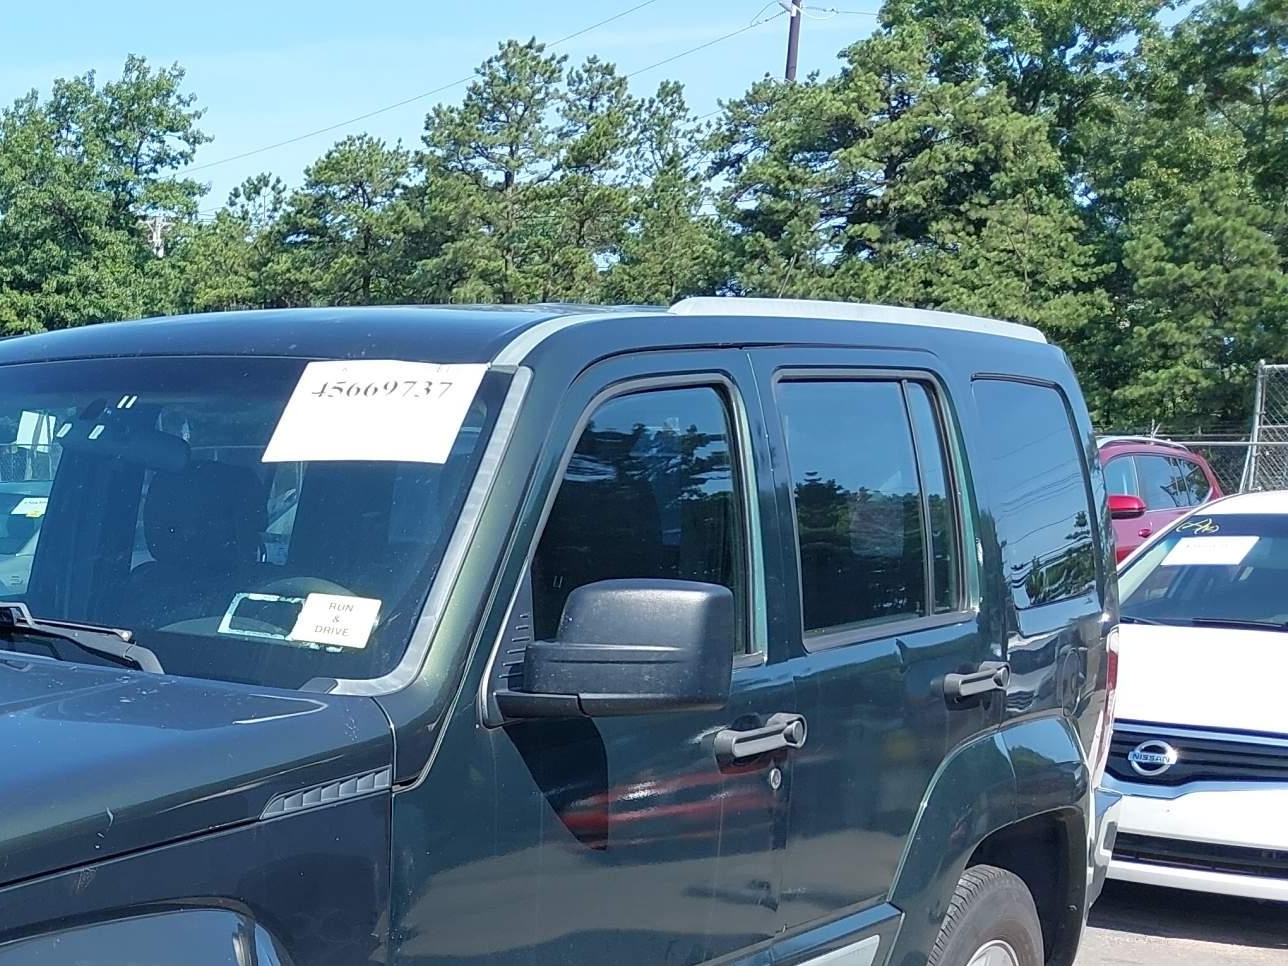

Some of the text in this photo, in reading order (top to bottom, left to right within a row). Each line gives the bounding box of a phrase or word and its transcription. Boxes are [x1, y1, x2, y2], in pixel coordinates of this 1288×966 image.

[311, 380, 454, 399] 45669737
[328, 601, 354, 612] RUN
[332, 615, 341, 624] &
[314, 625, 350, 636] DRIVE
[1131, 751, 1171, 763] NISSAN
